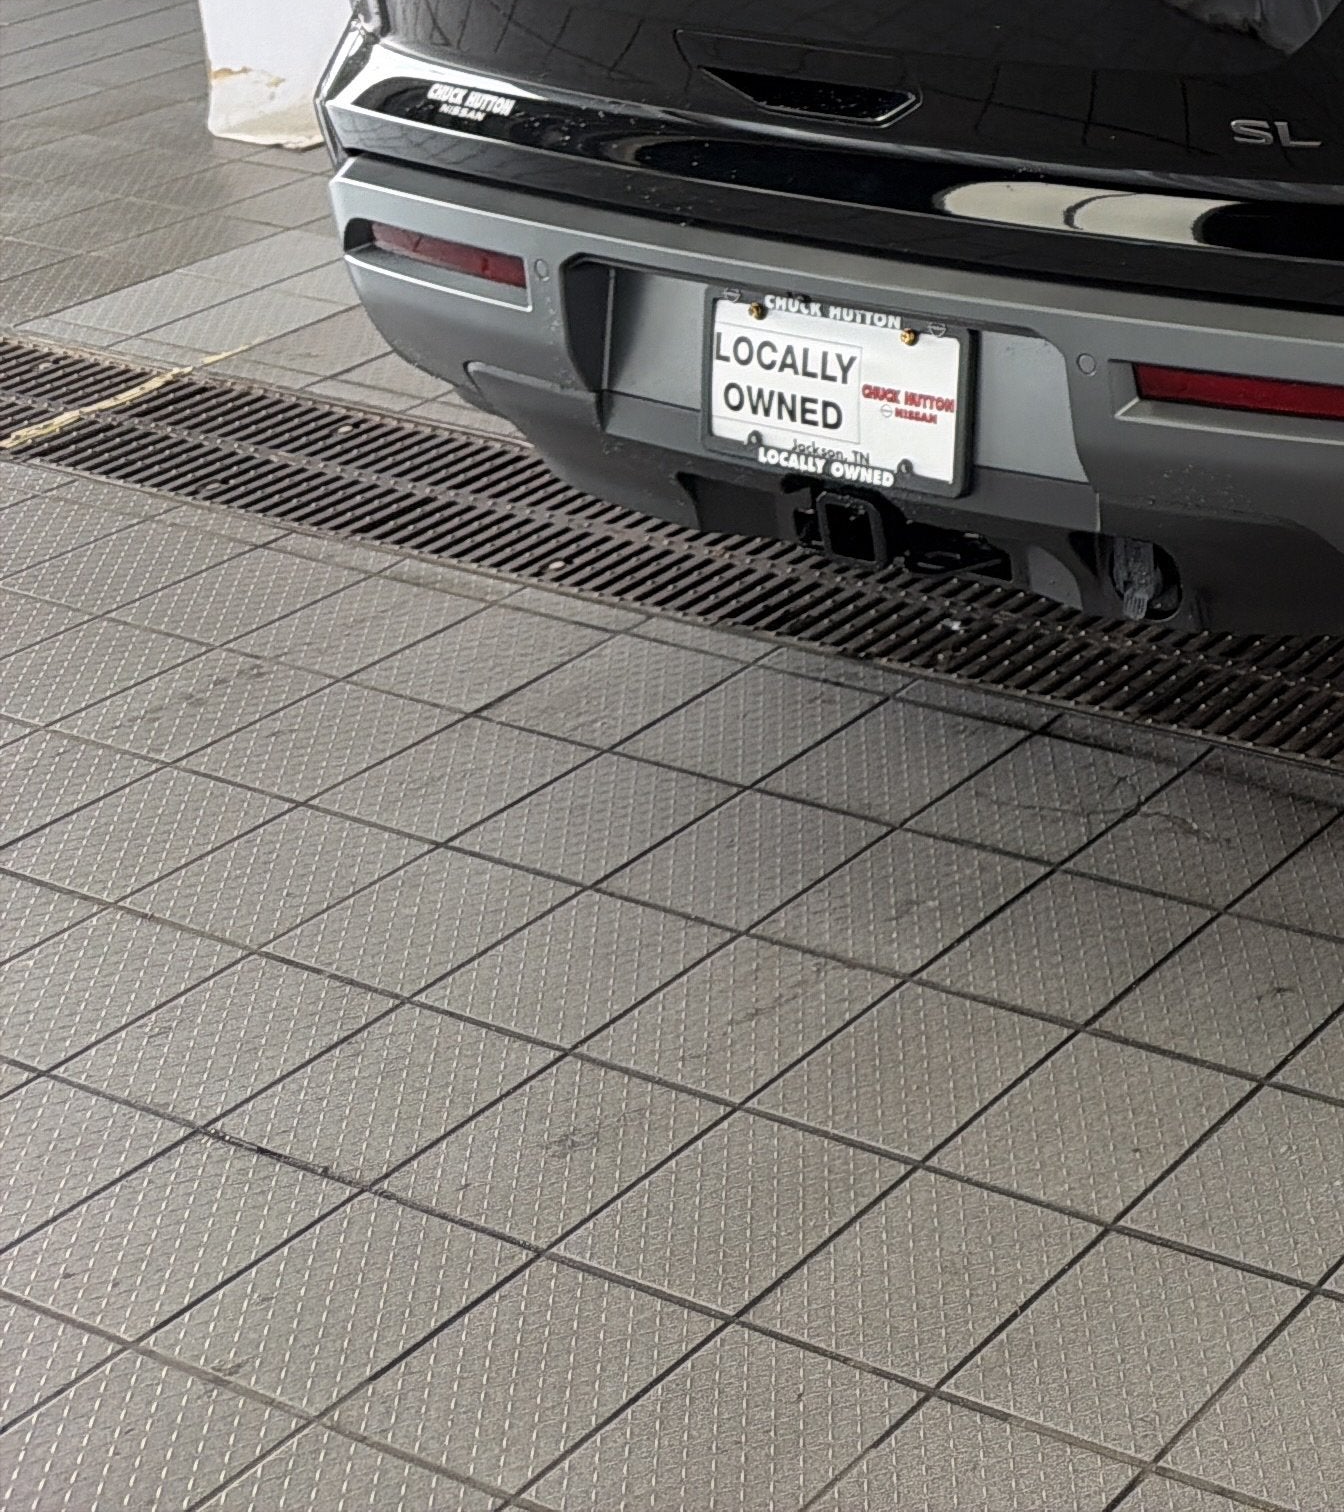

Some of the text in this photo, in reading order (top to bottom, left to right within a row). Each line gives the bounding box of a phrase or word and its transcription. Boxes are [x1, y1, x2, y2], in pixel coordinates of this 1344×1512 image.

[427, 83, 517, 117] CHUCK HUTTON
[1230, 119, 1323, 147] SL
[764, 294, 822, 317] CHUCK
[829, 305, 902, 330] HUTTON
[715, 331, 858, 385] LOCALLY
[723, 382, 843, 430] OWNED
[862, 383, 955, 414] CHUCK HUTTON
[895, 407, 938, 425] NISSAN
[758, 447, 895, 487] LOCALLY OWNED
[852, 449, 870, 465] TN
